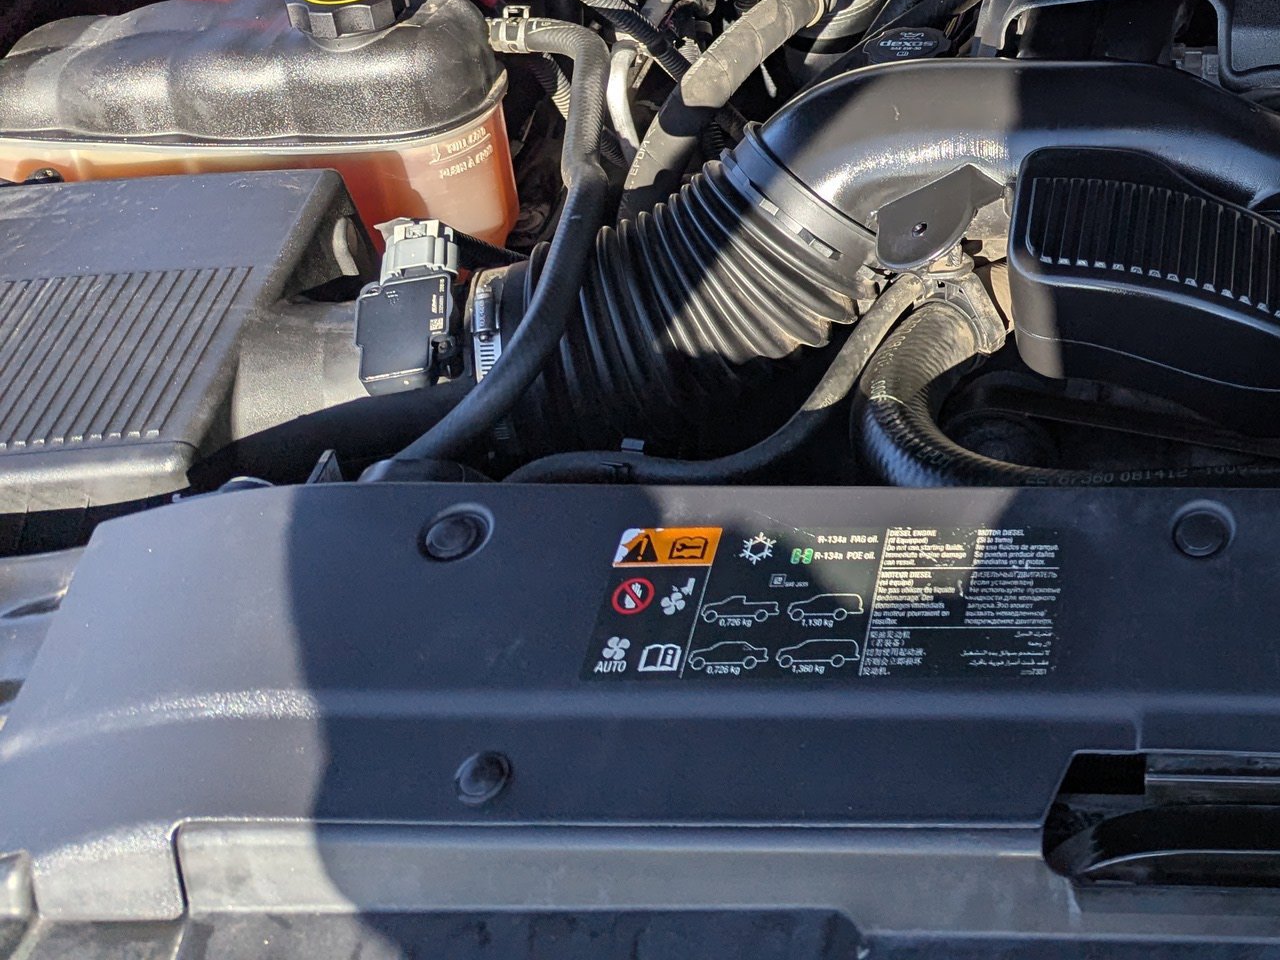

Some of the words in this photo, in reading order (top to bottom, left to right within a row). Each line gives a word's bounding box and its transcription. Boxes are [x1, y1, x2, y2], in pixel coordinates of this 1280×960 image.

[629, 140, 651, 176] EPDM
[889, 529, 911, 537] DIESEL
[912, 529, 937, 537] ENGINE
[976, 529, 1001, 537] MOTOR
[1002, 529, 1025, 537] DIESEL
[817, 535, 847, 543] R-134a
[849, 535, 867, 543] PAG
[867, 535, 879, 543] oil.
[814, 551, 843, 560] R-134a
[846, 551, 863, 560] POE
[863, 551, 876, 560] oil.
[719, 618, 741, 627] 0,726
[742, 618, 752, 627] kg
[801, 618, 822, 627] 1,130
[823, 618, 834, 627] kg
[593, 660, 627, 673] AUTO
[706, 665, 729, 674] 0,726
[730, 665, 741, 674] kg
[792, 664, 813, 674] 1,360
[814, 664, 825, 674] kg
